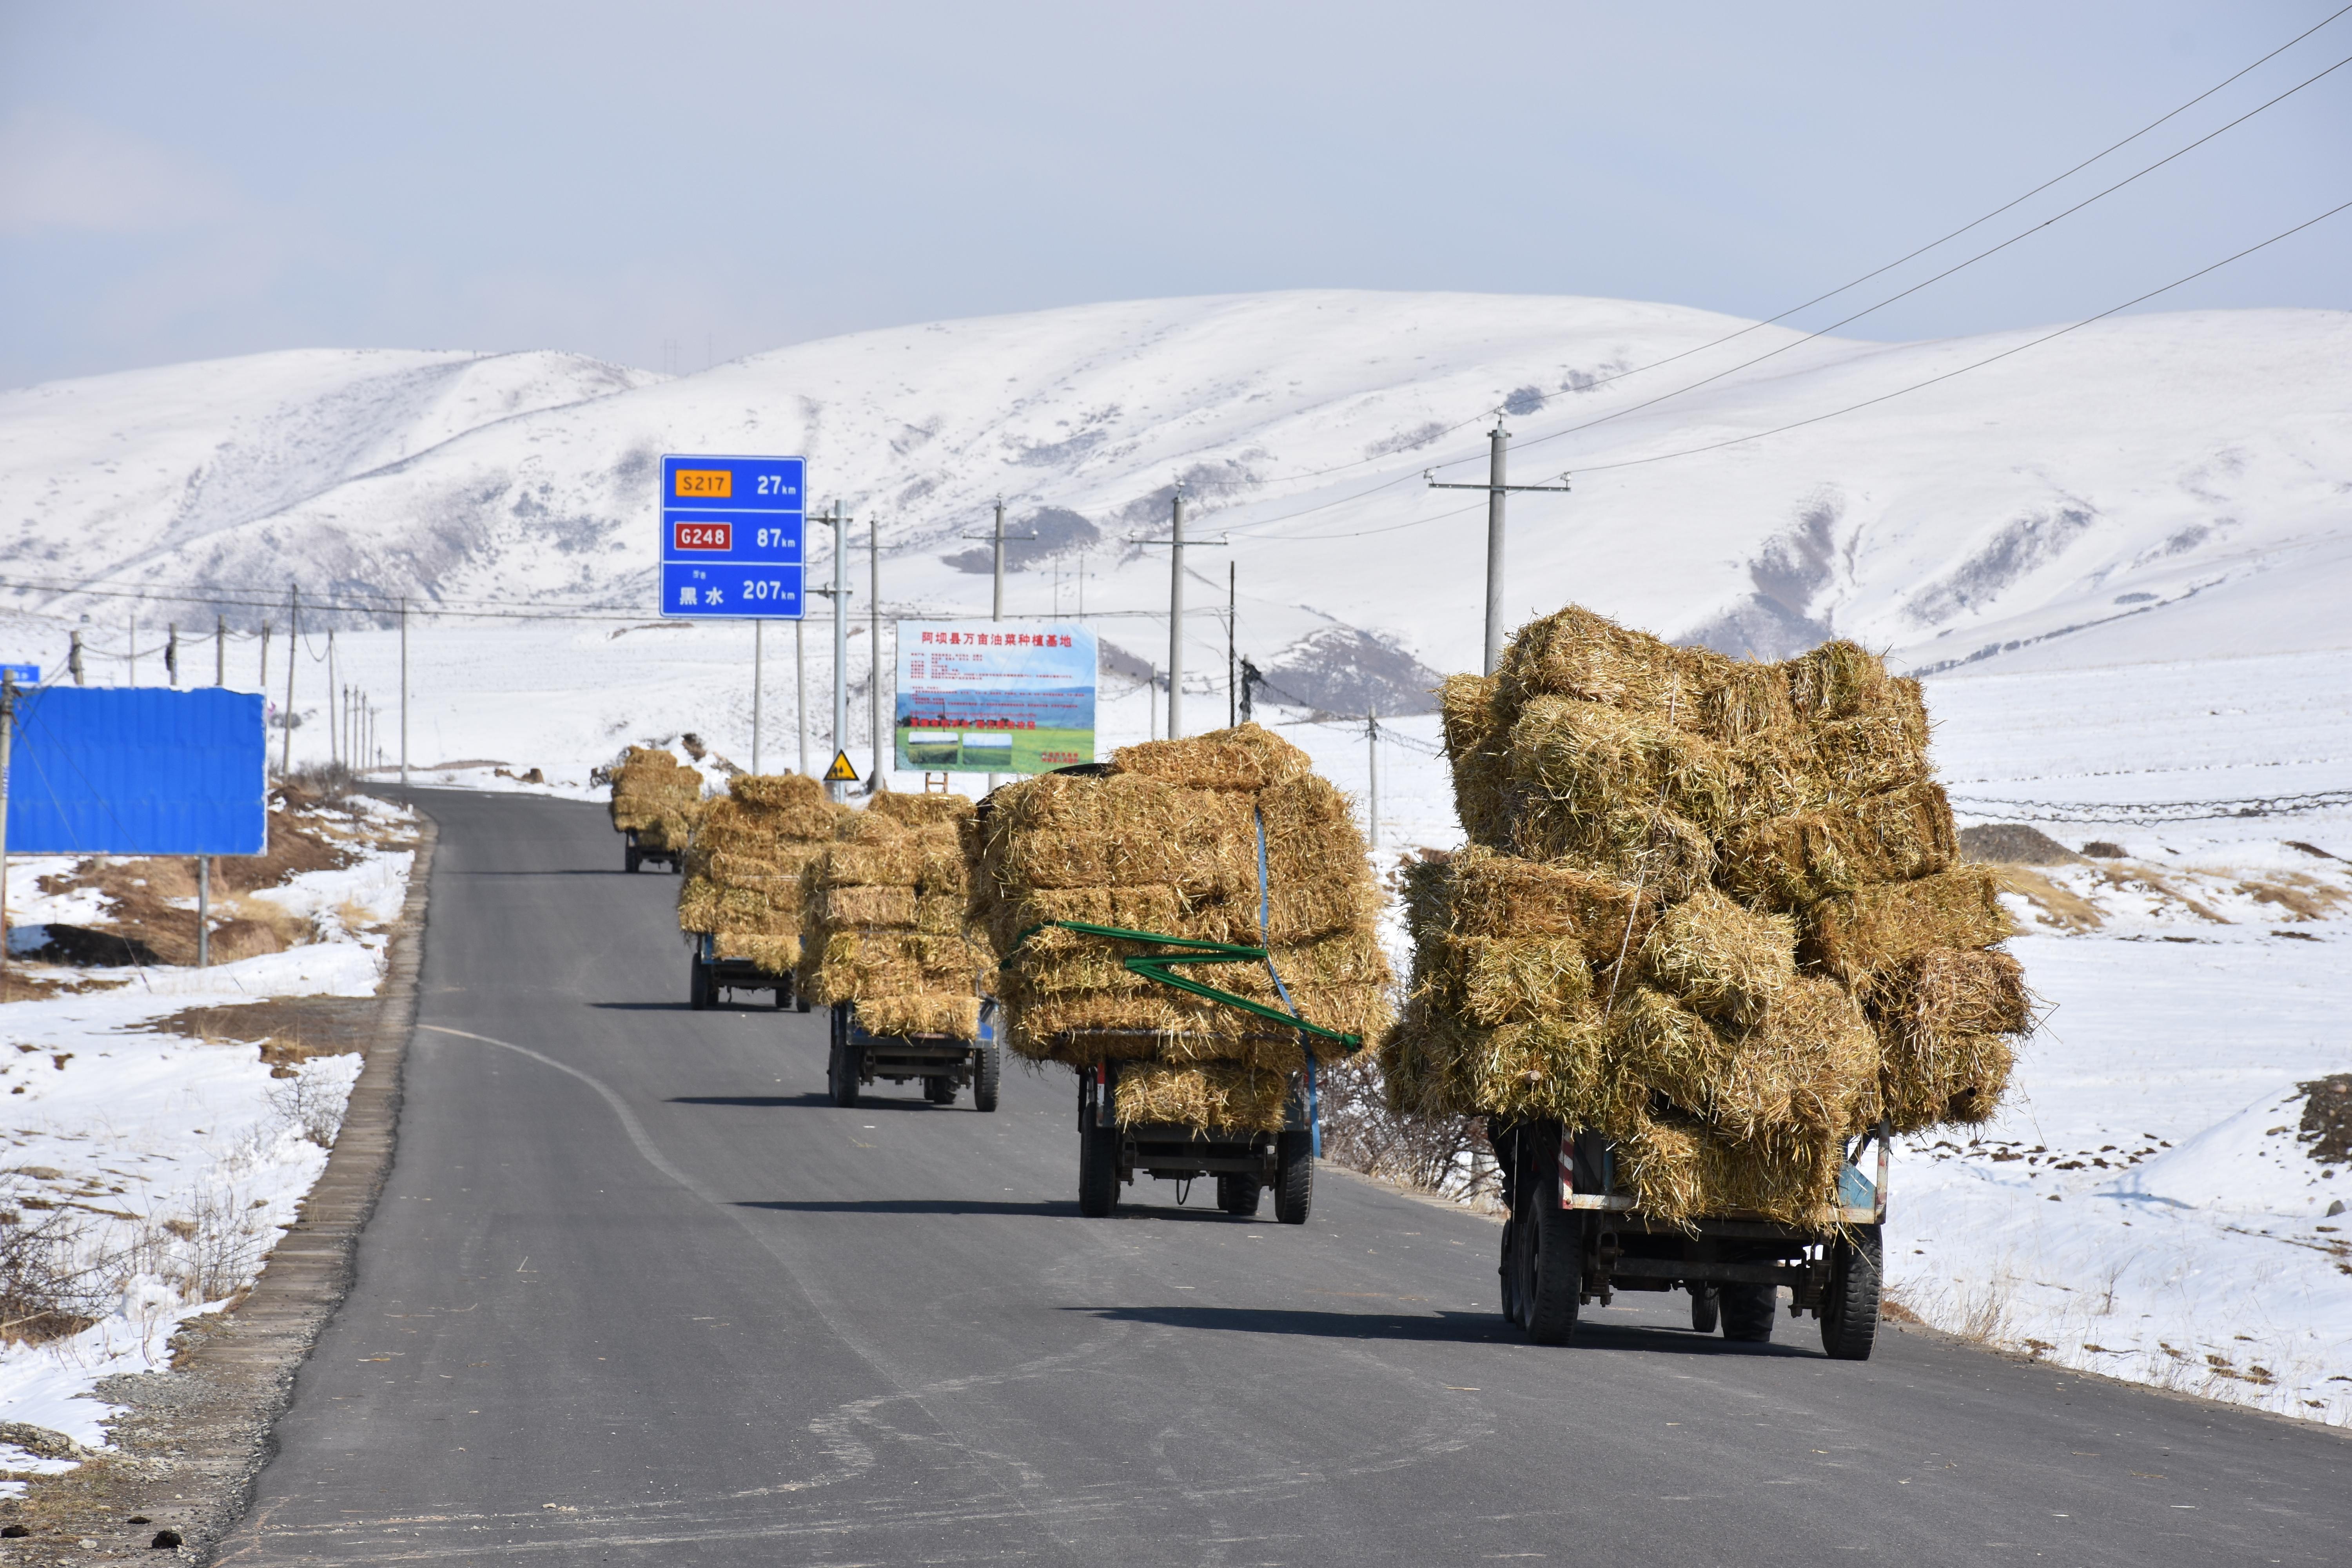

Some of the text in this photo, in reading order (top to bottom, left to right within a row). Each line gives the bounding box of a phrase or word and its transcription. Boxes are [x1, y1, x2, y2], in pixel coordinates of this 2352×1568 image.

[683, 476, 724, 491] S217
[681, 528, 725, 545] G248
[922, 632, 1072, 647] 阿坝县万亩油菜种植基地
